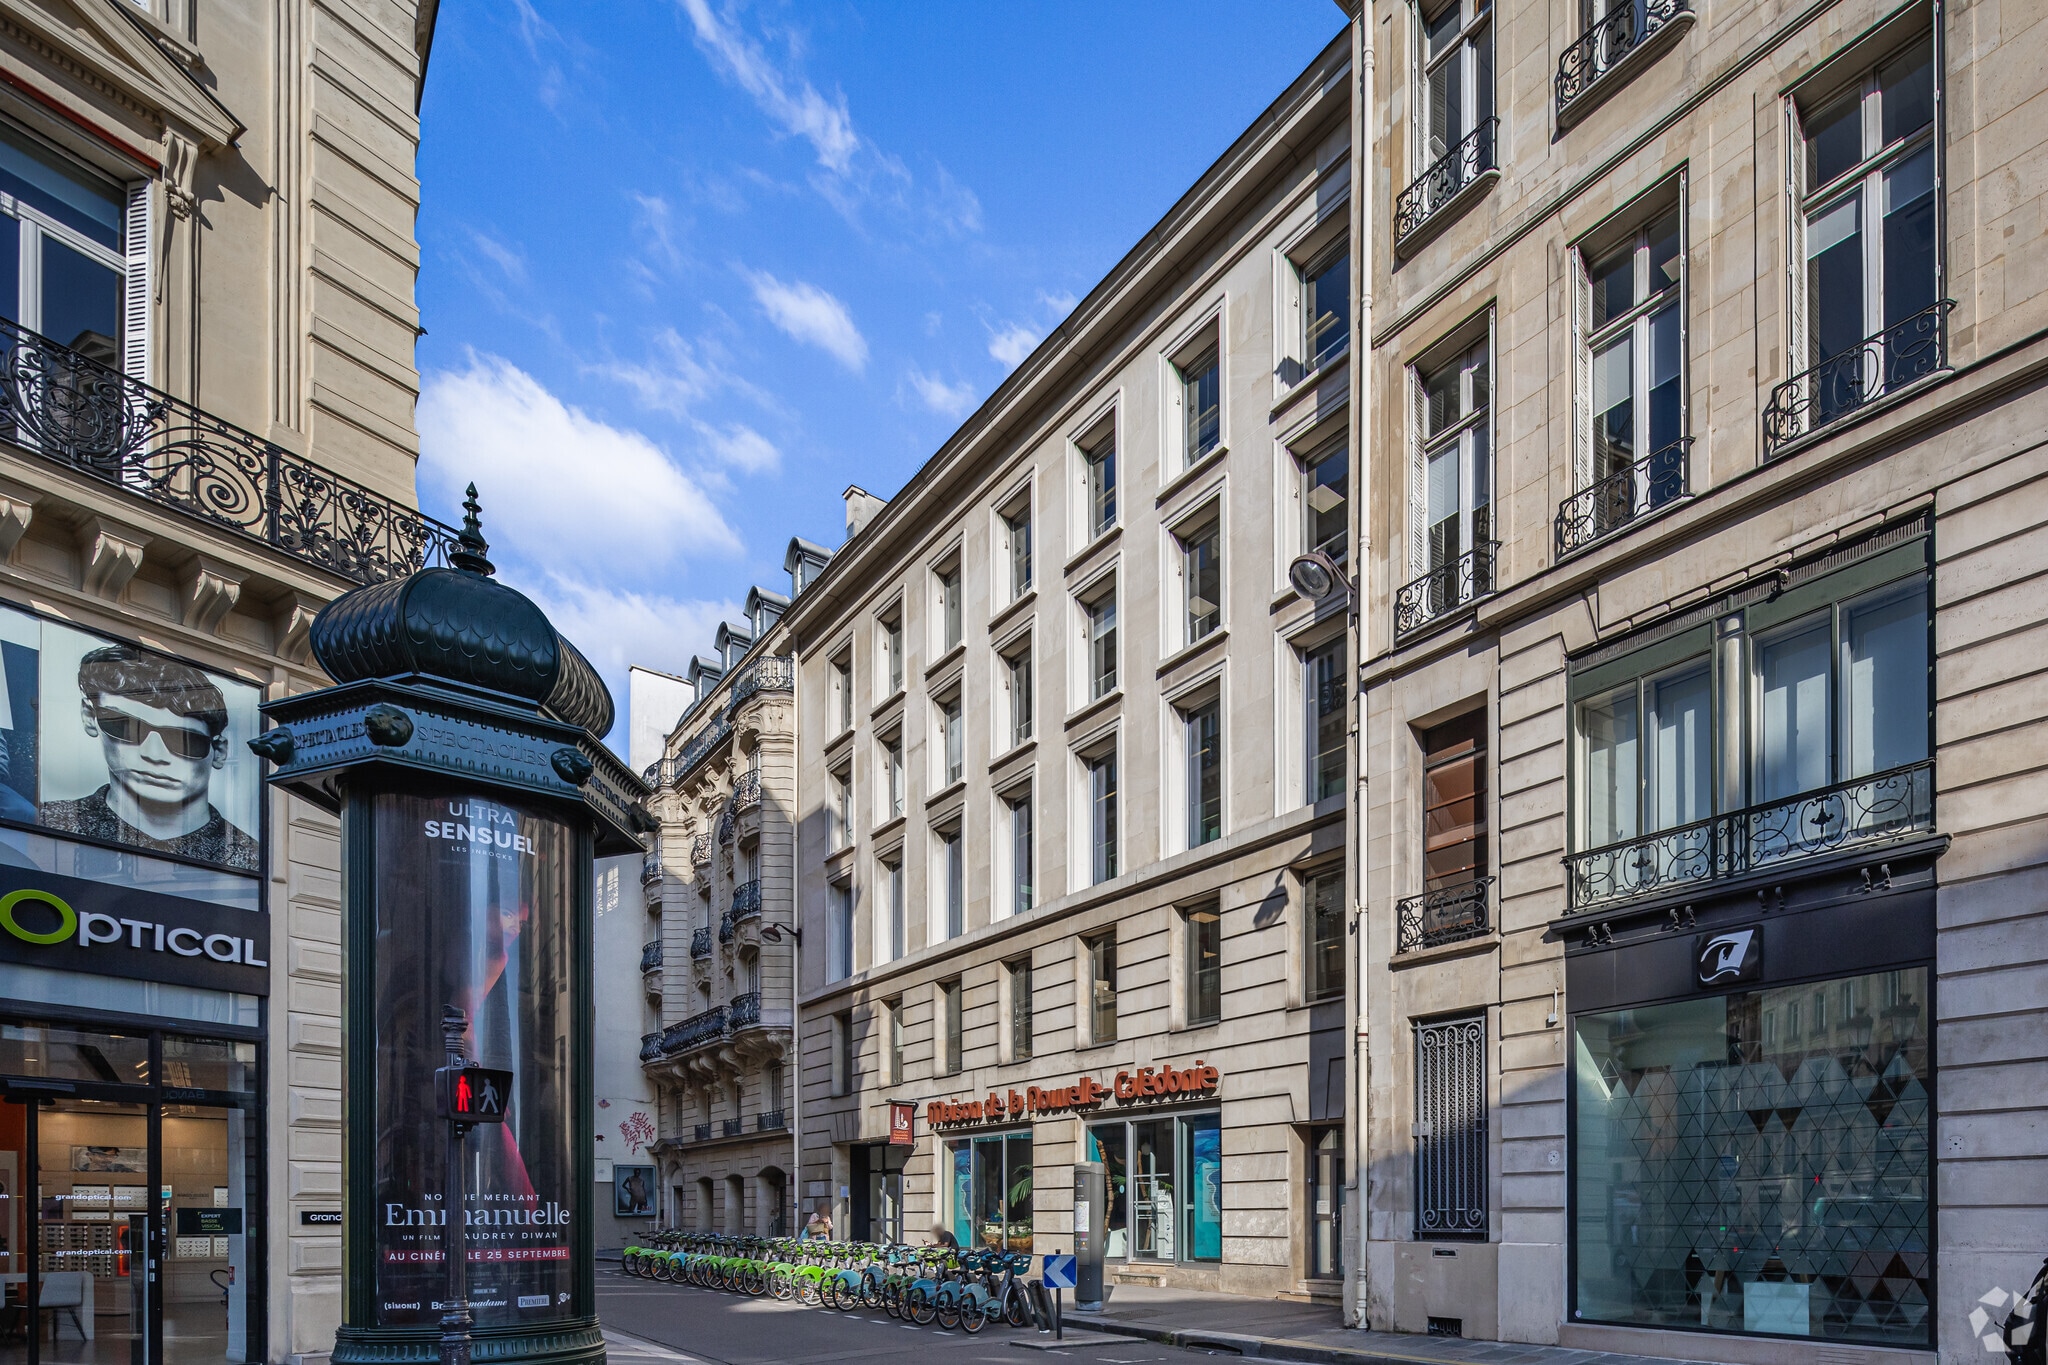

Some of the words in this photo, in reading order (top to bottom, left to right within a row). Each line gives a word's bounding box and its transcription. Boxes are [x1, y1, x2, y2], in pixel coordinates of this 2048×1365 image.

[417, 726, 548, 767] SPECTACLES
[449, 802, 515, 827] ULTRA
[424, 820, 536, 856] SENSUEL
[471, 849, 513, 861] INROCKS
[984, 1092, 1006, 1117] de
[1008, 1089, 1024, 1114] la
[906, 1179, 911, 1190] 4
[484, 1193, 541, 1201] MERLANT
[521, 1232, 558, 1240] DIWAN
[55, 1248, 132, 1257] grandoptical.com
[389, 1252, 405, 1261] AU
[468, 1252, 481, 1260] LE
[487, 1251, 502, 1260] 25
[508, 1249, 567, 1259] SEPTEMBRE
[468, 1298, 508, 1308] madame
